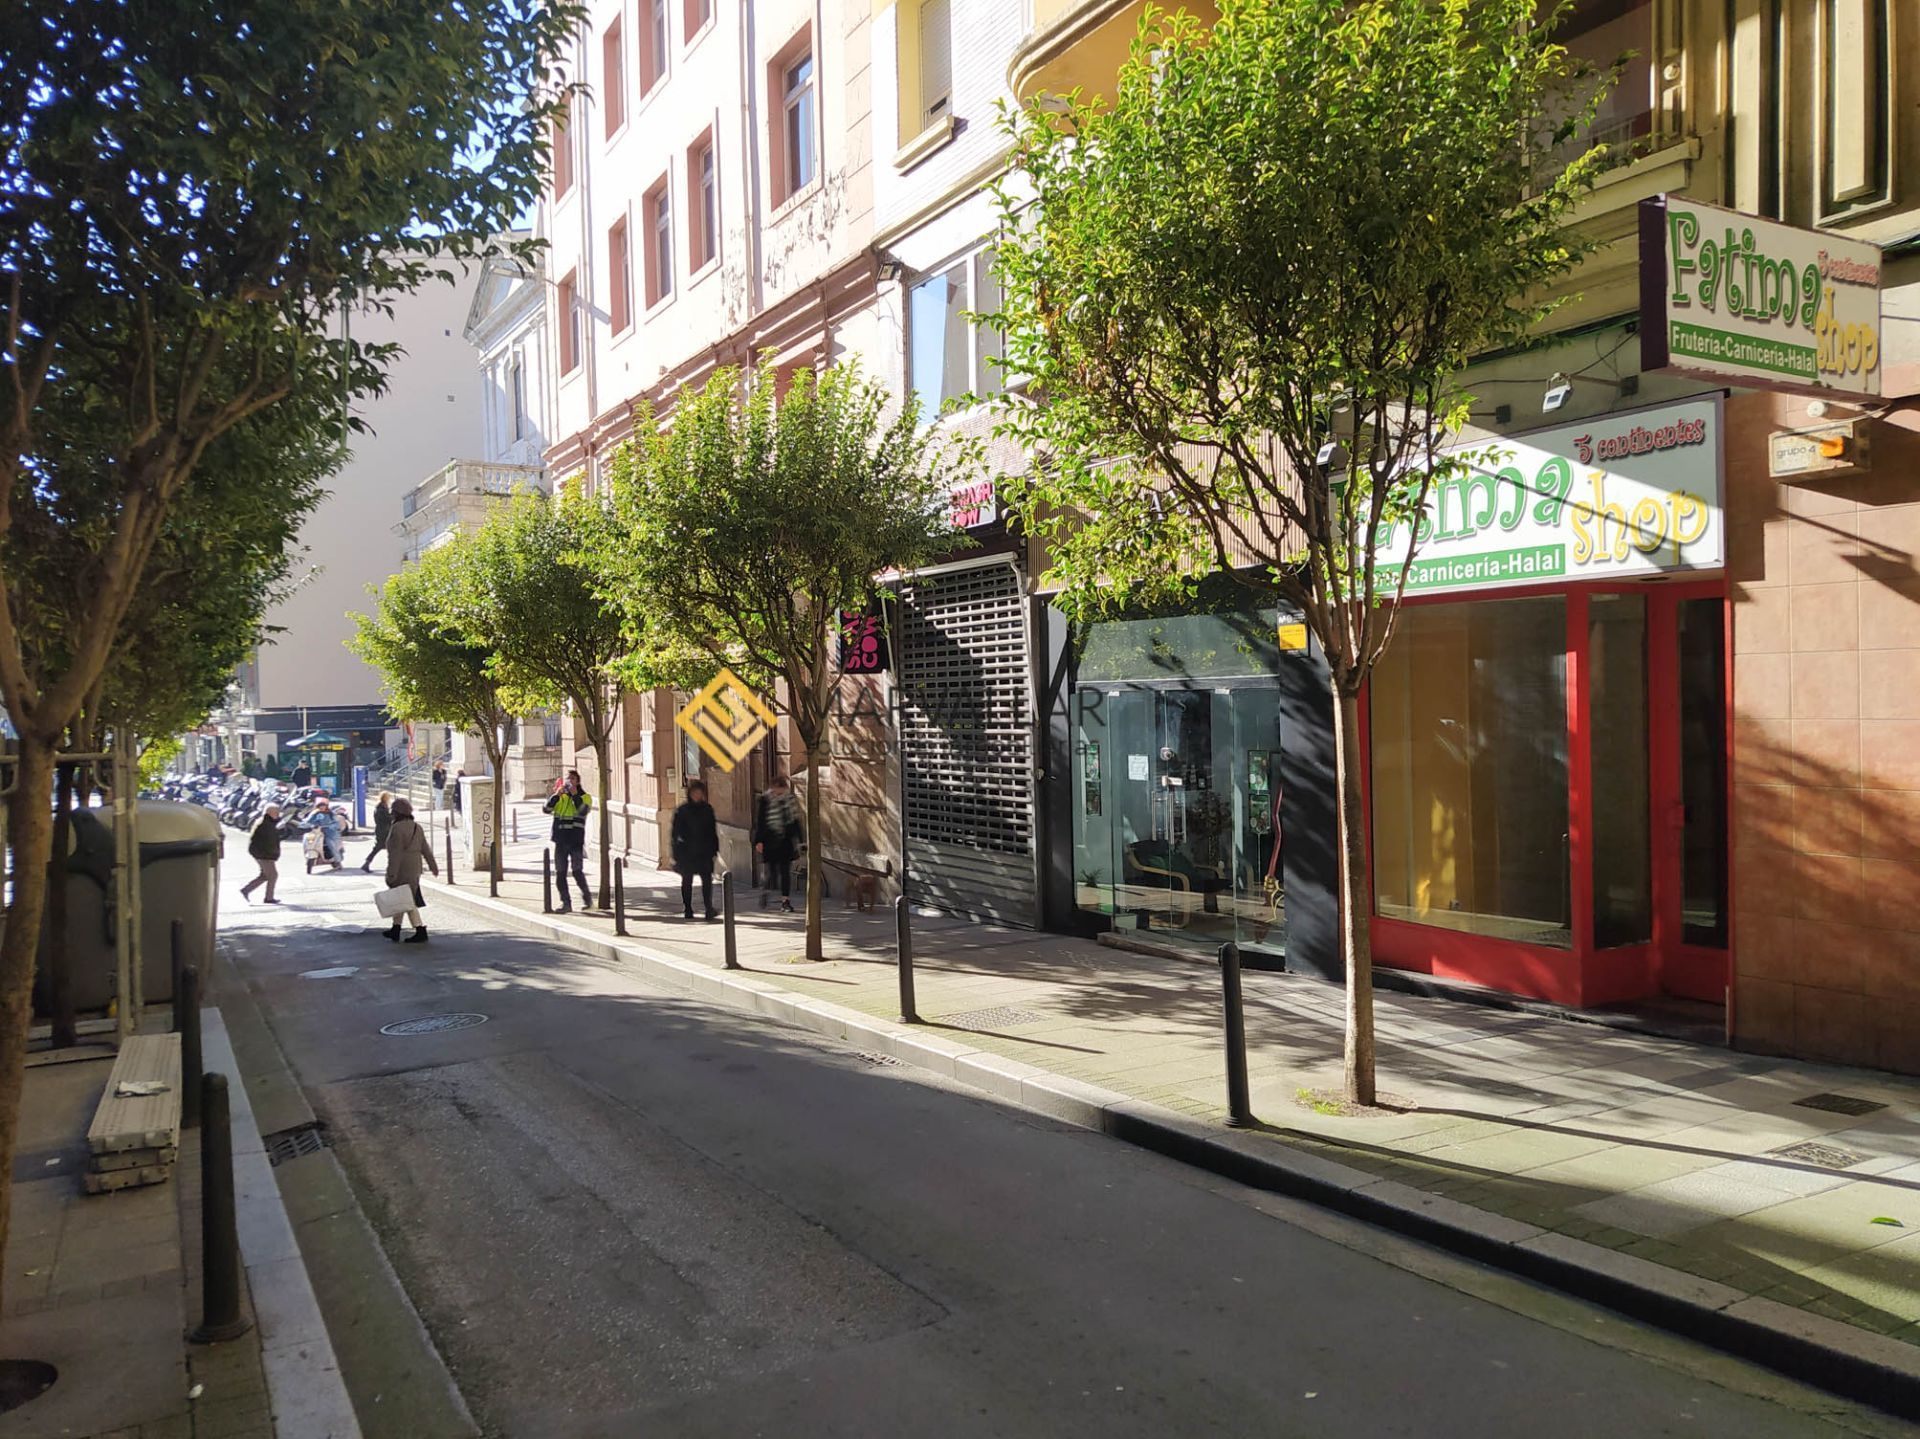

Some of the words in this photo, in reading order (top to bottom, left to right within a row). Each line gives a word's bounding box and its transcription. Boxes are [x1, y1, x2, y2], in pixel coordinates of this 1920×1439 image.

[1667, 211, 1822, 331] Fatima
[1815, 287, 1878, 389] shop
[1574, 434, 1592, 464] 5
[1597, 418, 1704, 459] continentes
[1776, 447, 1807, 459] grupo
[1571, 469, 1708, 565] shop
